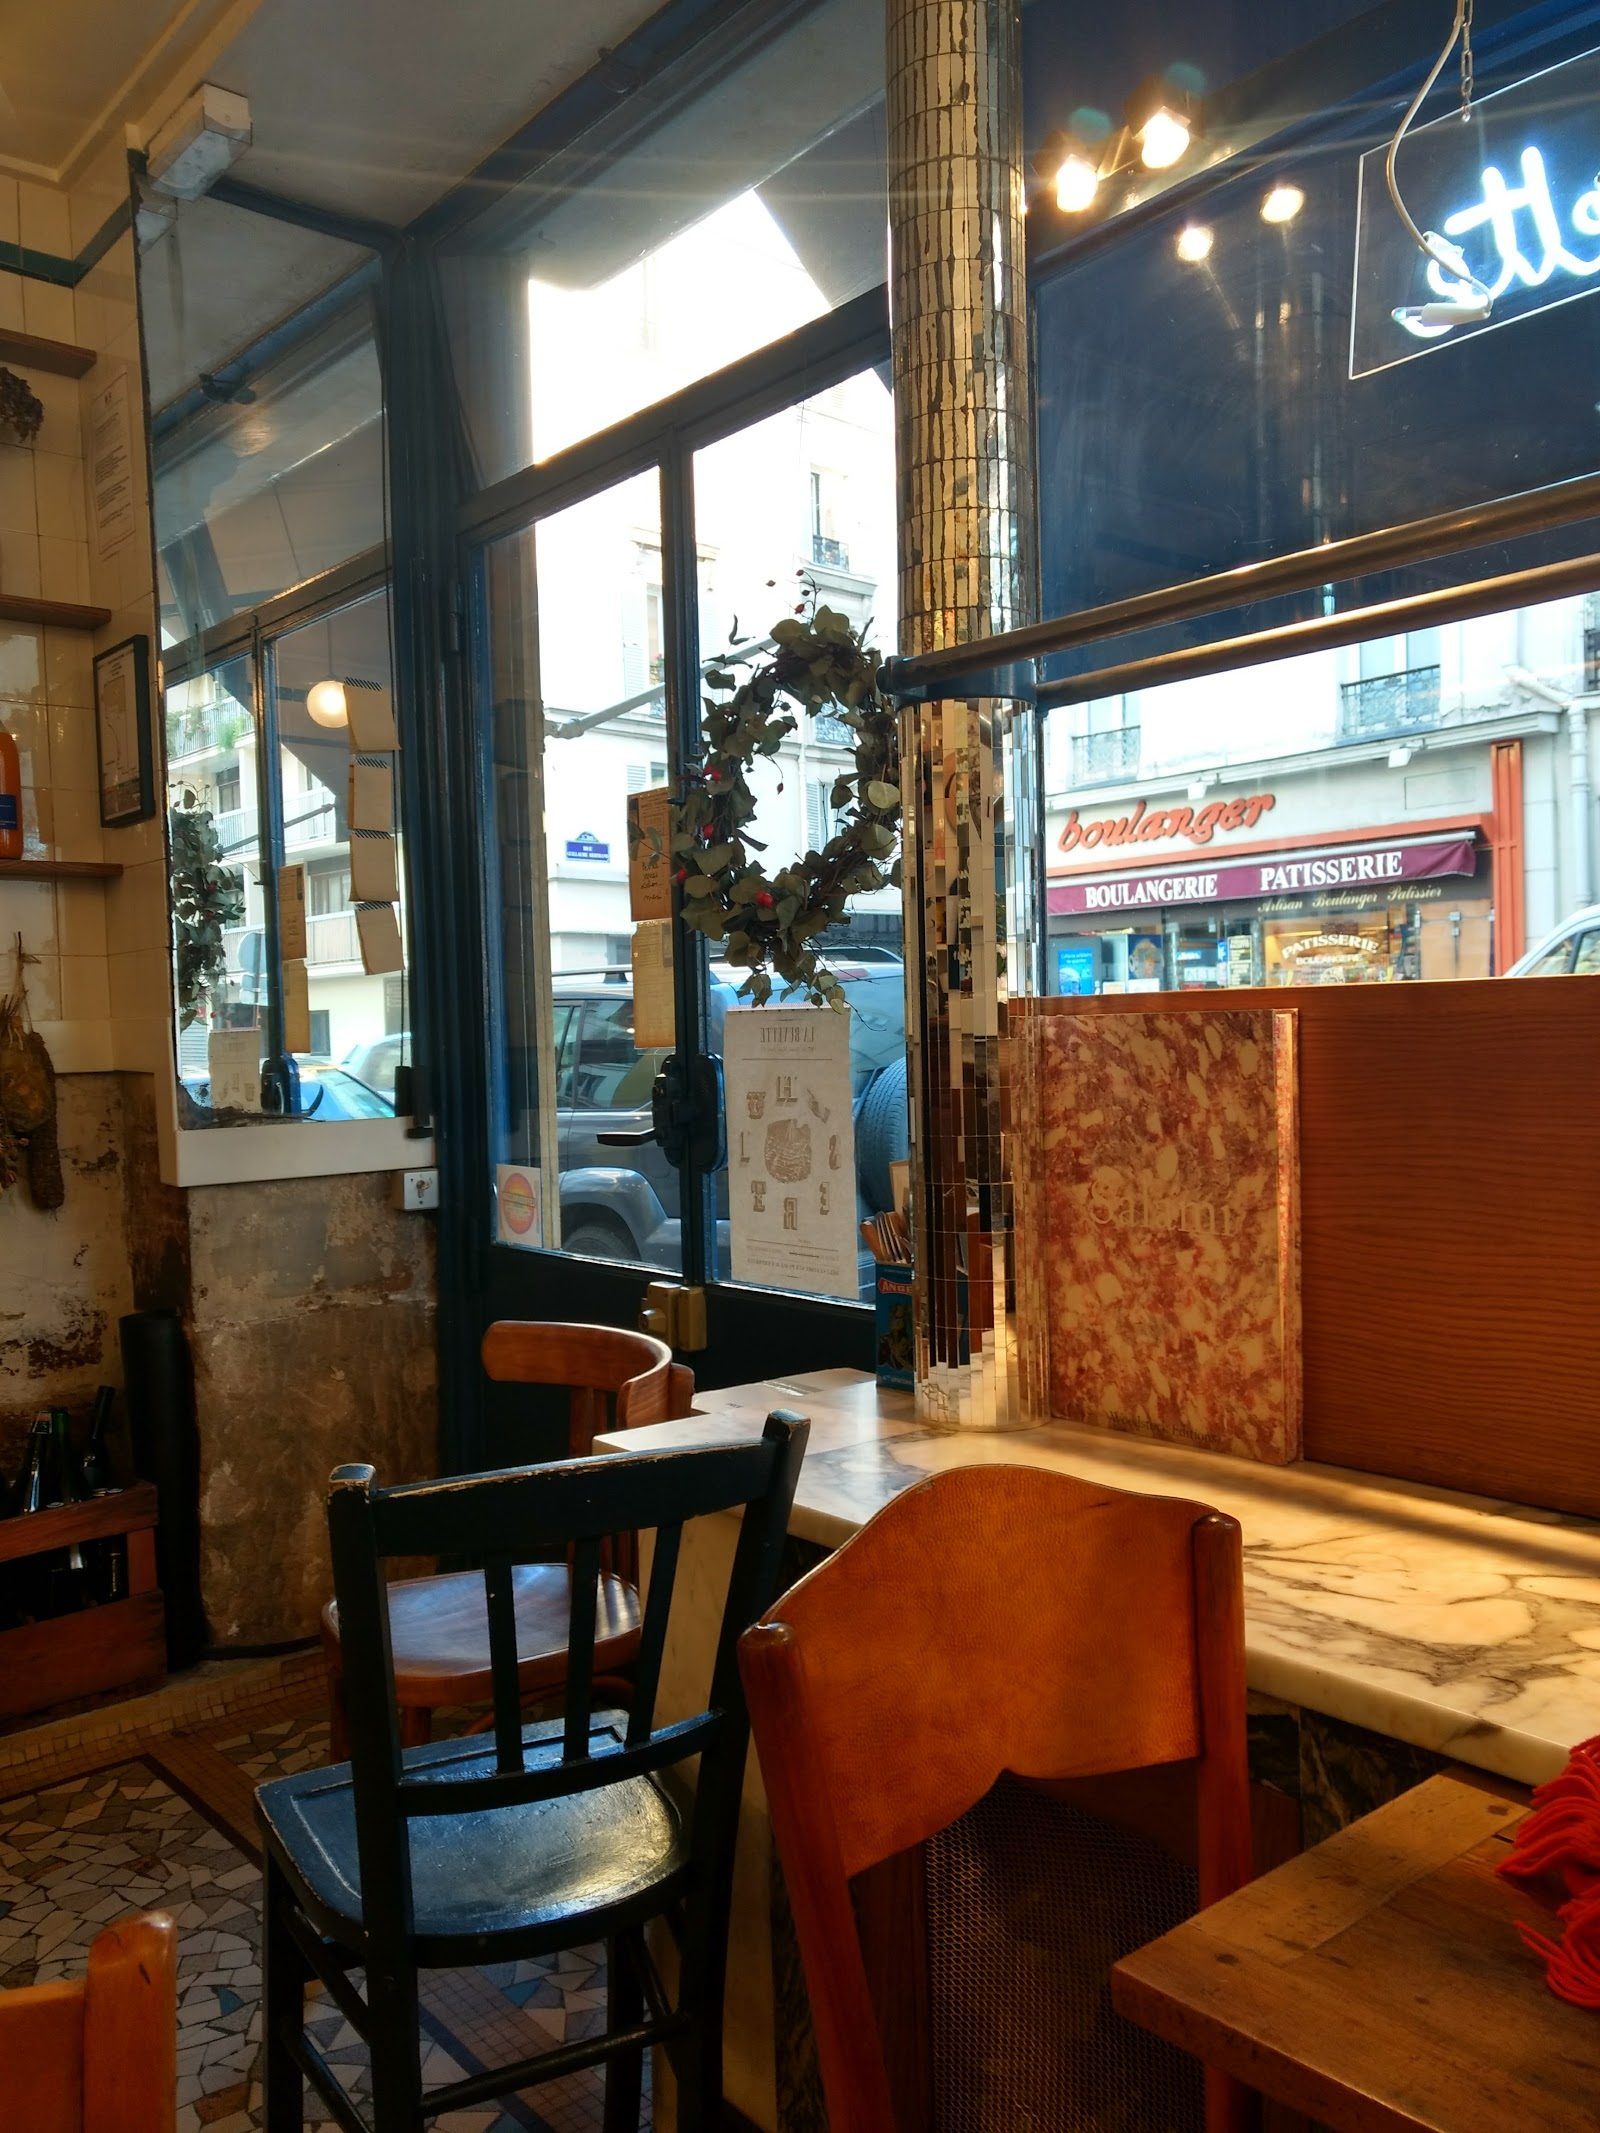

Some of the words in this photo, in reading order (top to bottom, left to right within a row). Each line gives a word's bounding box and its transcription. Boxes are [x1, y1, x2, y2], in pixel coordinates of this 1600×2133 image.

[1058, 793, 1276, 852] boulanger
[1085, 874, 1218, 908] BOULANGERIE
[1260, 851, 1403, 891] PATISSERIE
[1258, 899, 1303, 913] Artisan
[1312, 892, 1378, 910] Boulanger
[1281, 933, 1380, 959] PATISSERIE
[1088, 1169, 1235, 1236] Salami
[882, 1280, 913, 1293] ANGE
